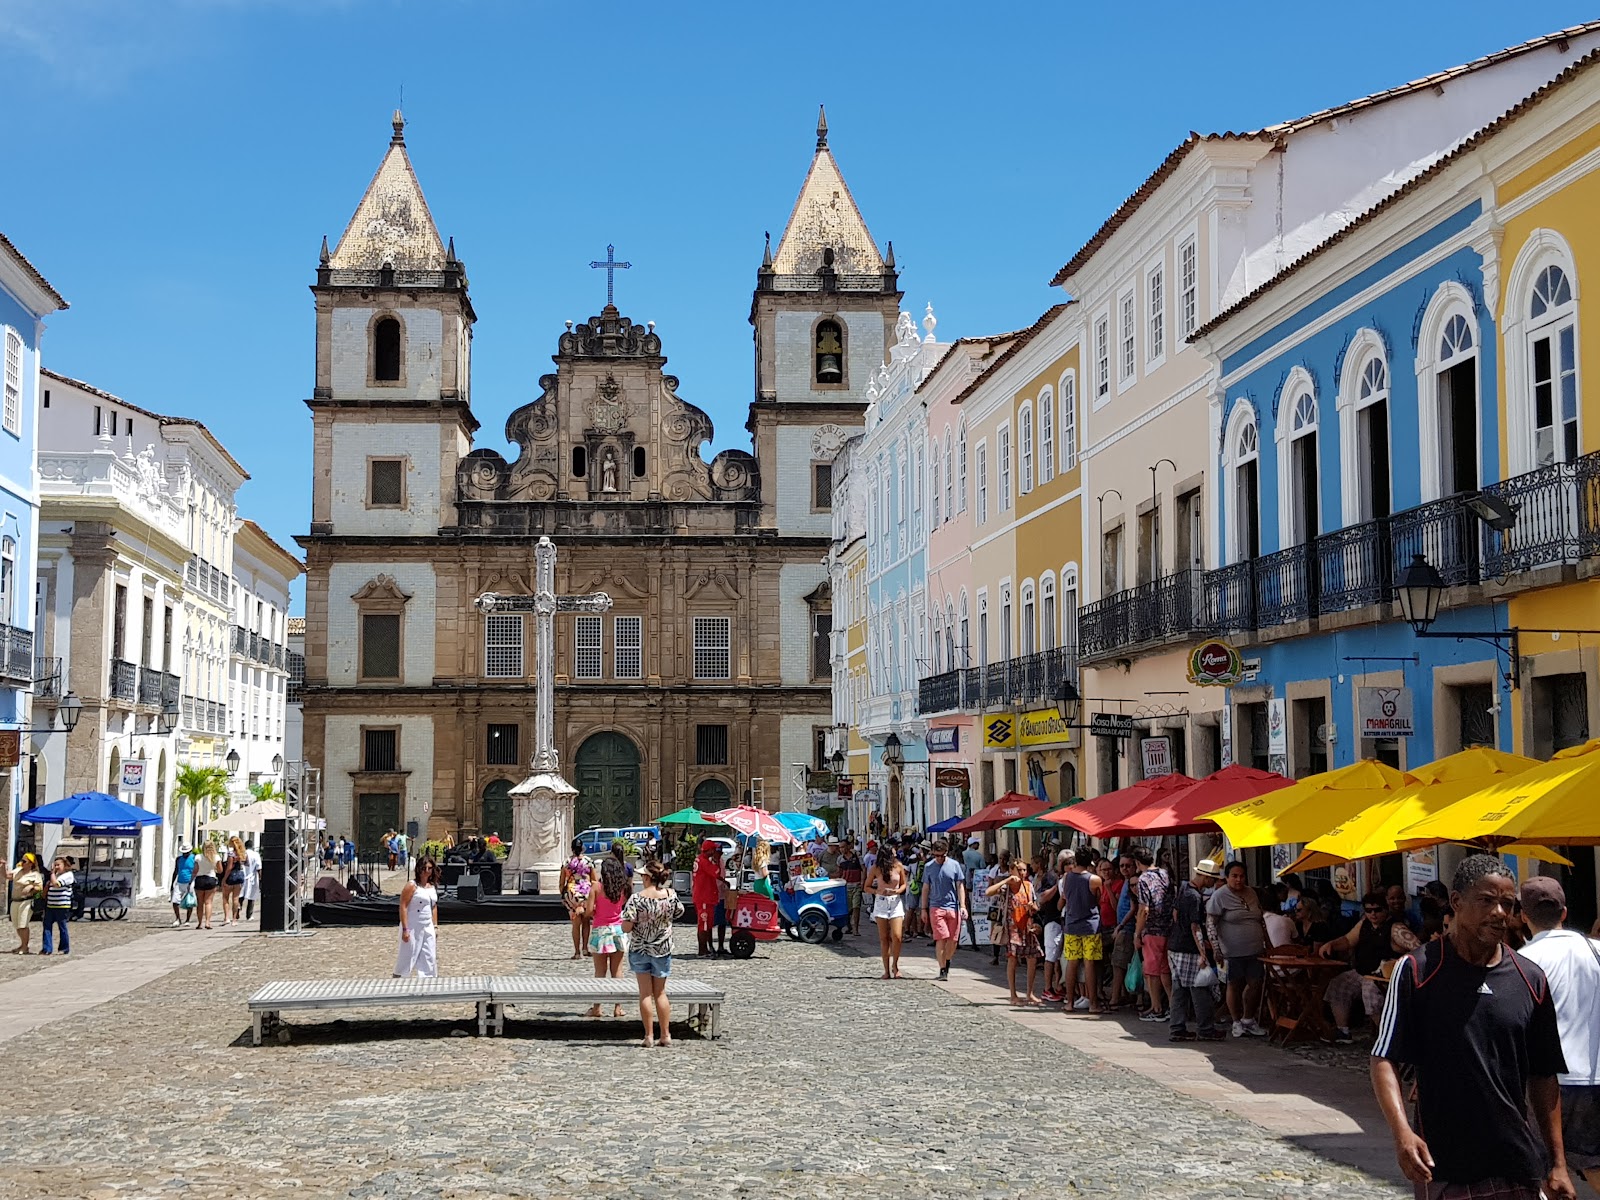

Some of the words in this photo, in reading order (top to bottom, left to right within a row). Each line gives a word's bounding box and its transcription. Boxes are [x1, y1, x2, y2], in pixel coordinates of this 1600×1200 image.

[1201, 653, 1227, 666] Roma
[1026, 720, 1041, 736] BANCO
[1048, 716, 1066, 733] BRASIL
[1092, 713, 1110, 727] Koisa
[1110, 714, 1132, 728] Nossa
[1118, 729, 1131, 737] ARTE
